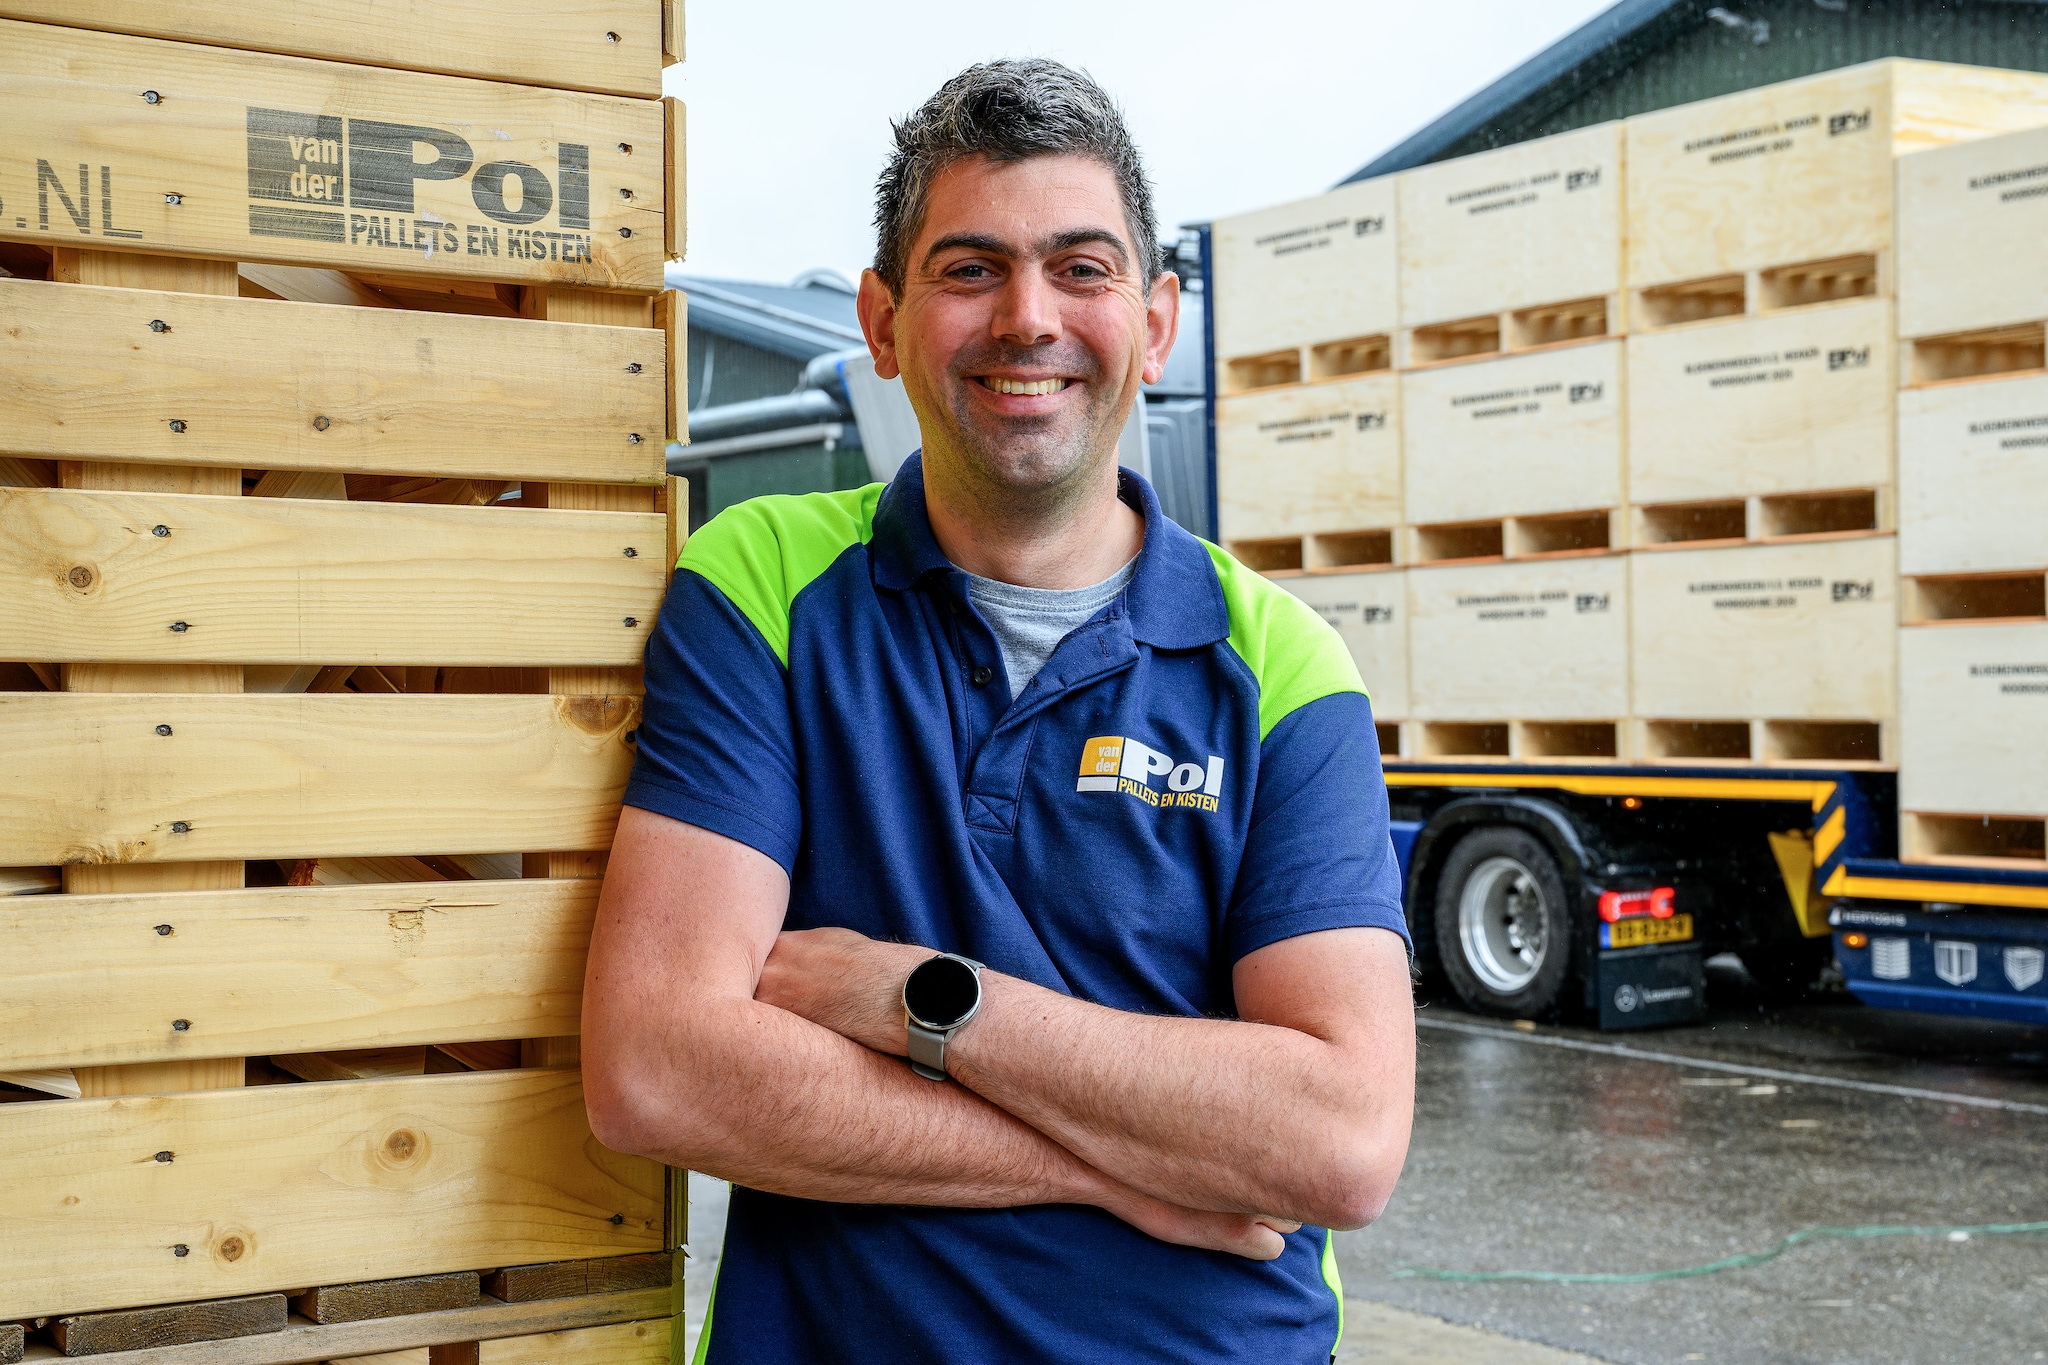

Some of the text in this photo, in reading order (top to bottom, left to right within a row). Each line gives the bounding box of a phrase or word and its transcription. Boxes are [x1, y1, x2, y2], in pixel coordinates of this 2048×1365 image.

[288, 135, 339, 165] van
[290, 164, 338, 201] der
[348, 118, 591, 231] Pol
[0, 158, 144, 240] .NL
[350, 213, 593, 264] PALLETS EN KISTEN
[1095, 757, 1118, 773] der
[1098, 745, 1120, 758] van
[1119, 737, 1225, 798] Pol
[1118, 778, 1220, 813] PALLETS EN KISTEN
